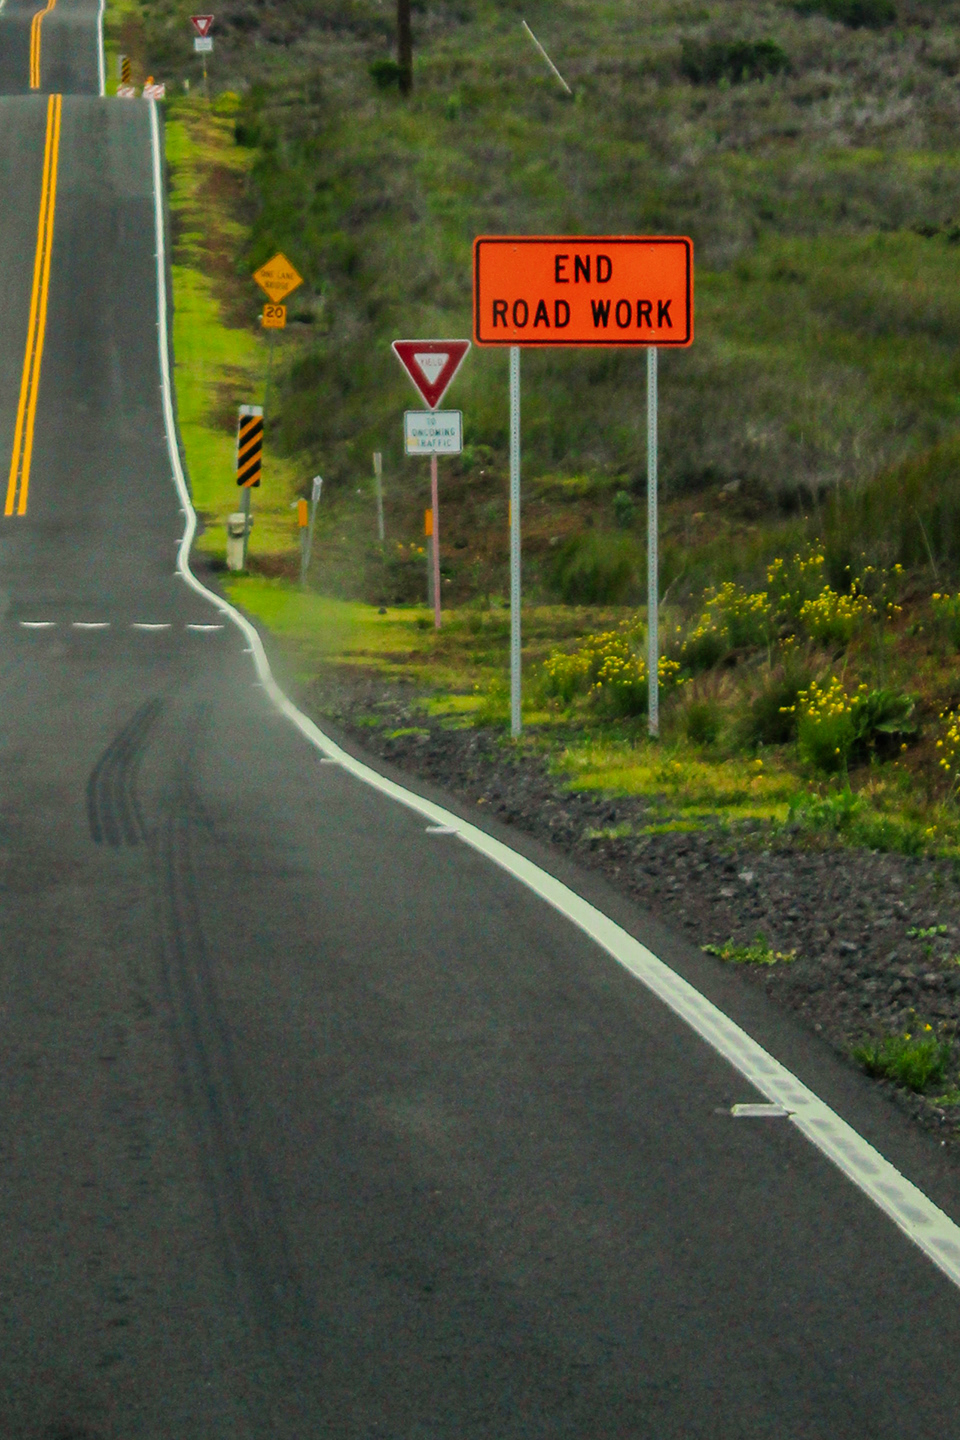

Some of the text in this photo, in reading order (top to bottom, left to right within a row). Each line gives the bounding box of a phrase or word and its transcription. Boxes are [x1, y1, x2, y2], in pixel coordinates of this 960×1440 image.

[555, 254, 613, 284] END
[266, 306, 283, 318] 20
[492, 299, 674, 328] ROAD WORK
[421, 358, 443, 366] YIELD
[411, 427, 455, 437] ONCOMING
